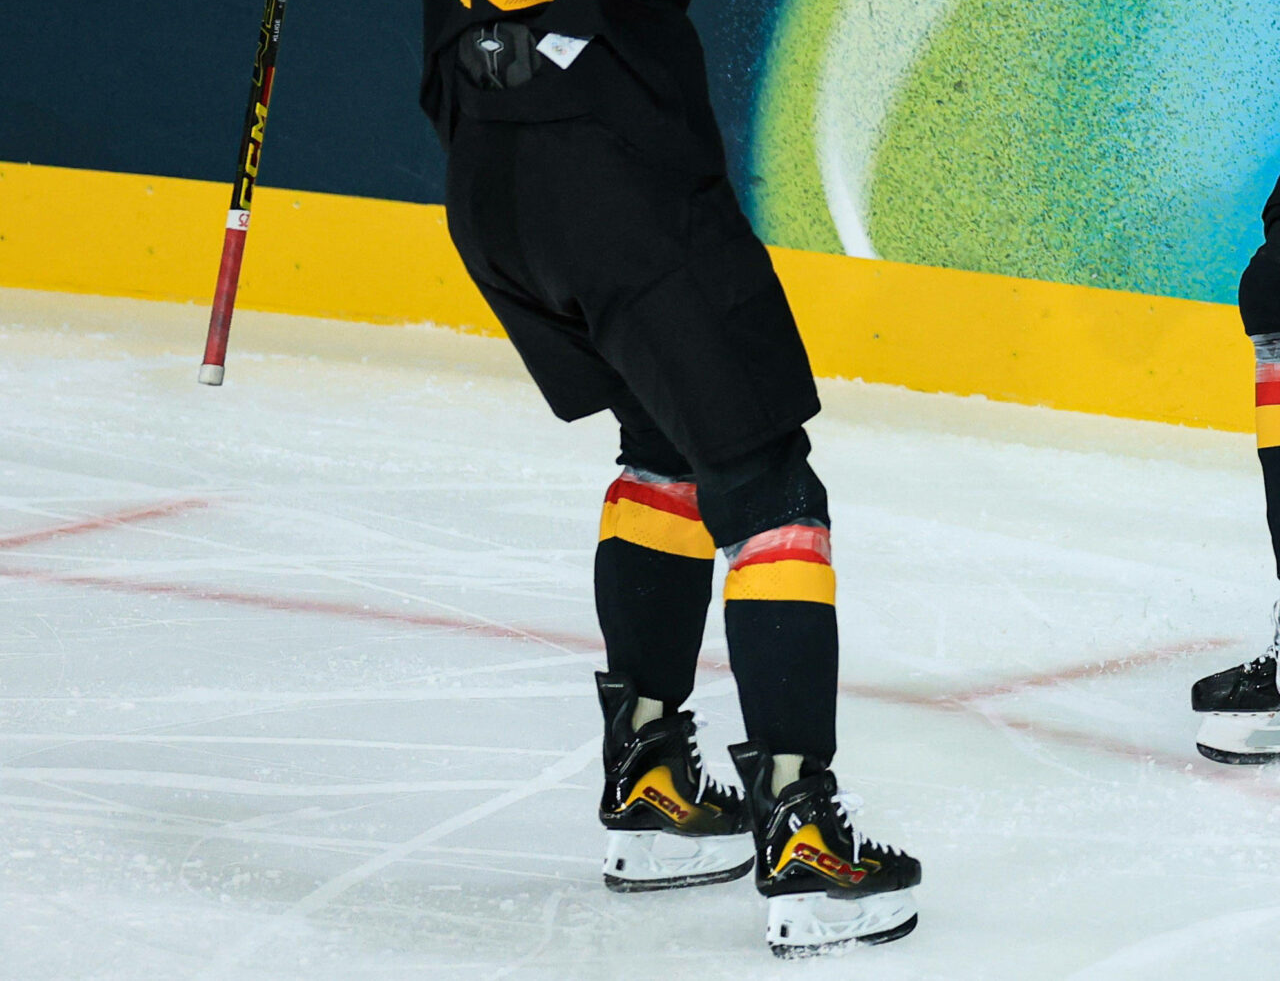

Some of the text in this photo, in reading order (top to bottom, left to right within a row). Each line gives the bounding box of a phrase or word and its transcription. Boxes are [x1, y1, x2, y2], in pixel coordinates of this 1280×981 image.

[239, 102, 269, 210] CCM
[642, 785, 690, 820] CCM
[792, 842, 868, 885] CCM
